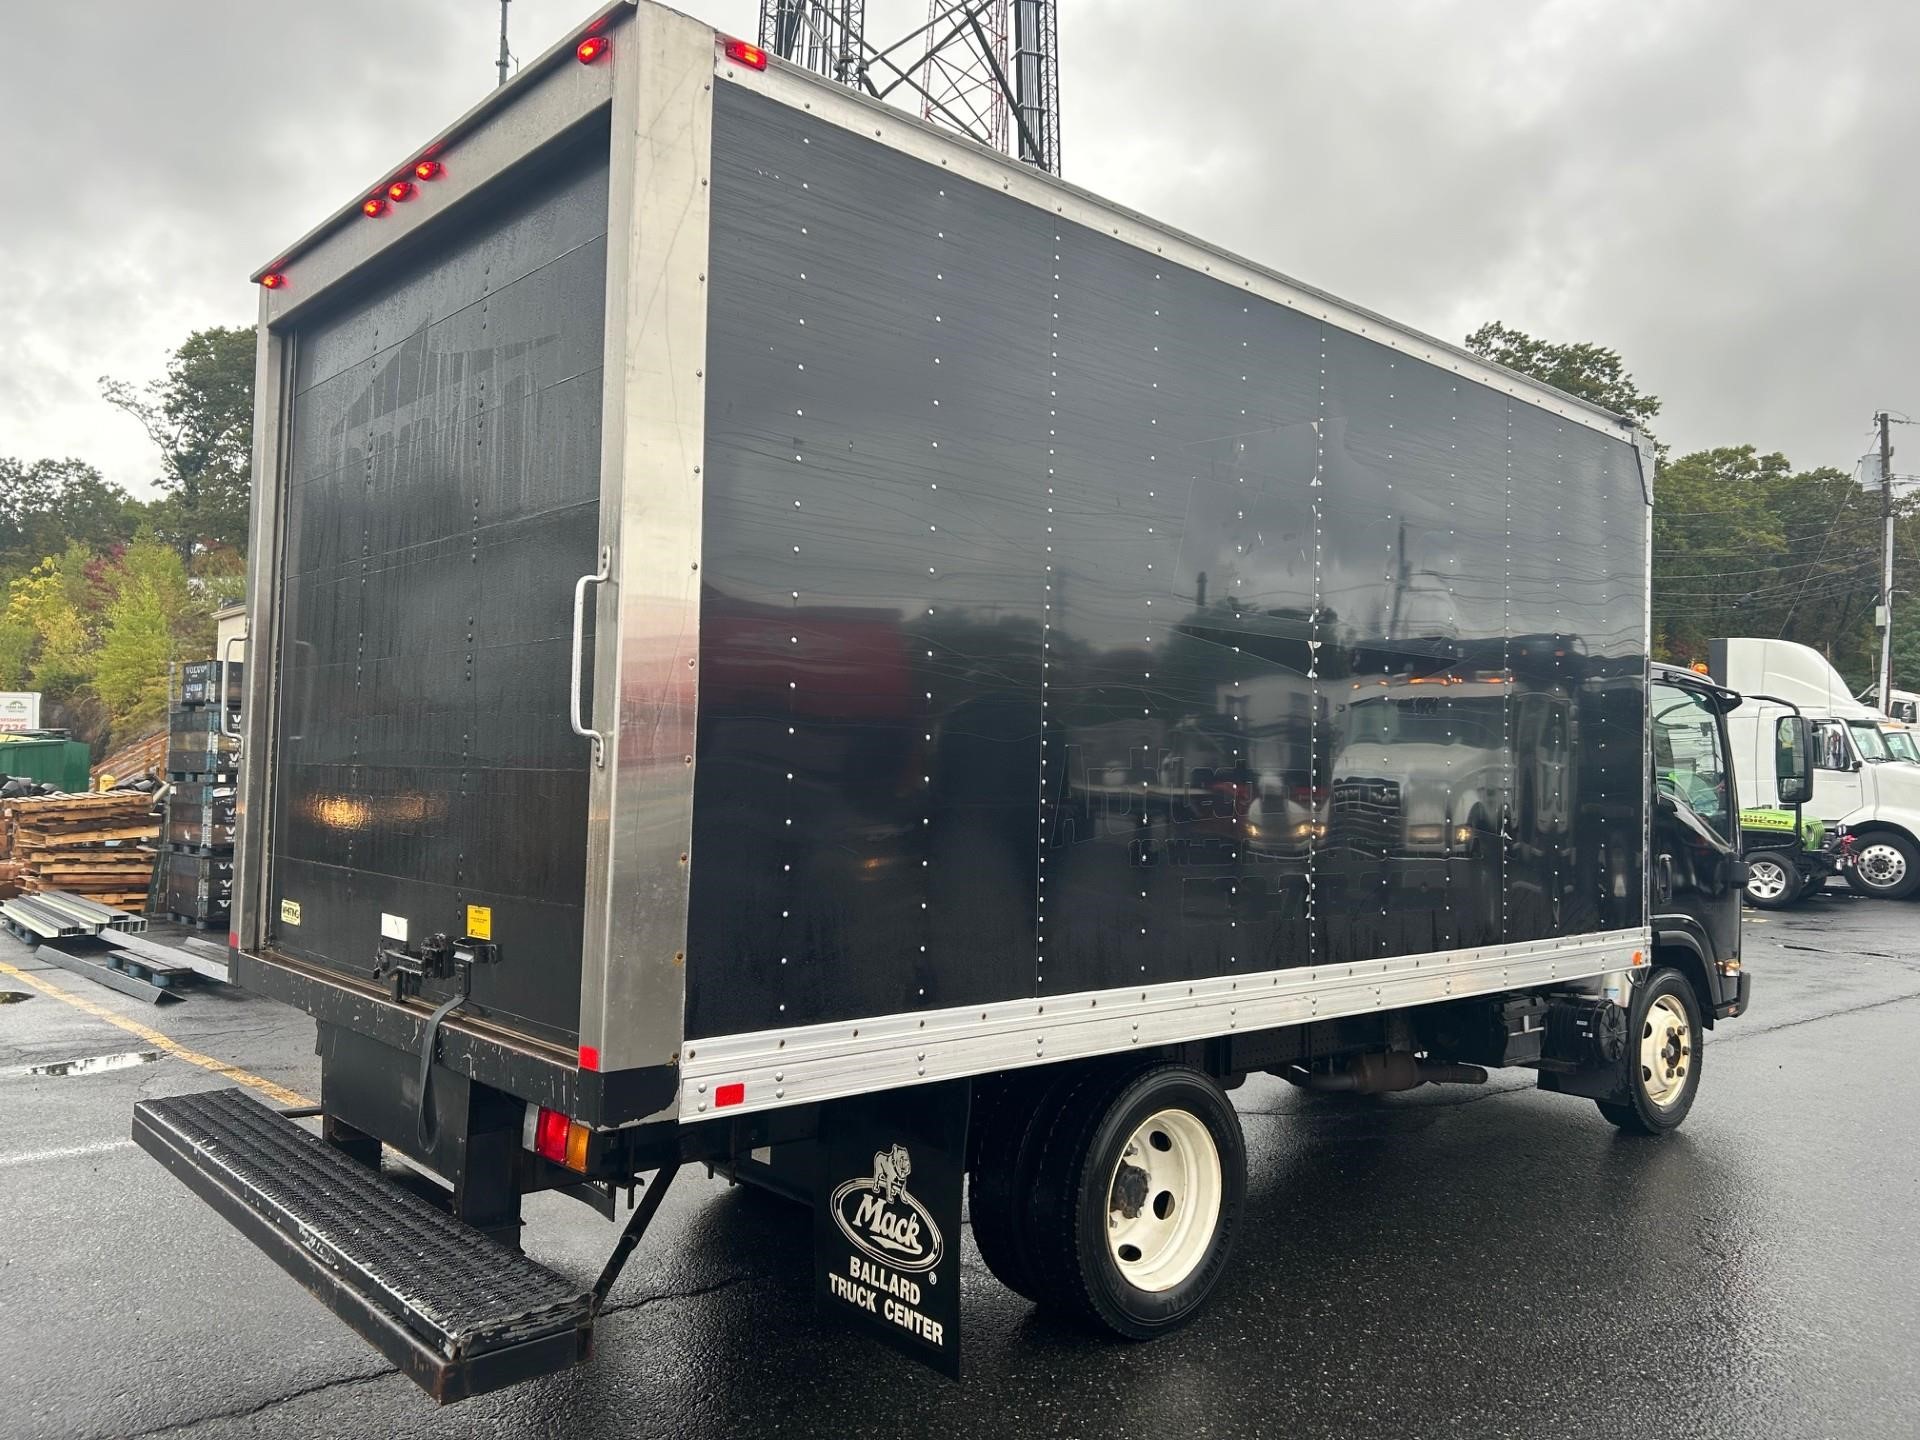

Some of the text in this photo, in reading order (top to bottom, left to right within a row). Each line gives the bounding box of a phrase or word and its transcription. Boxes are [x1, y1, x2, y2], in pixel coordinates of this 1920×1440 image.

[852, 1193, 923, 1255] Mack
[828, 1272, 944, 1346] TRUCK CENTER
[849, 1255, 921, 1306] BALLARD
